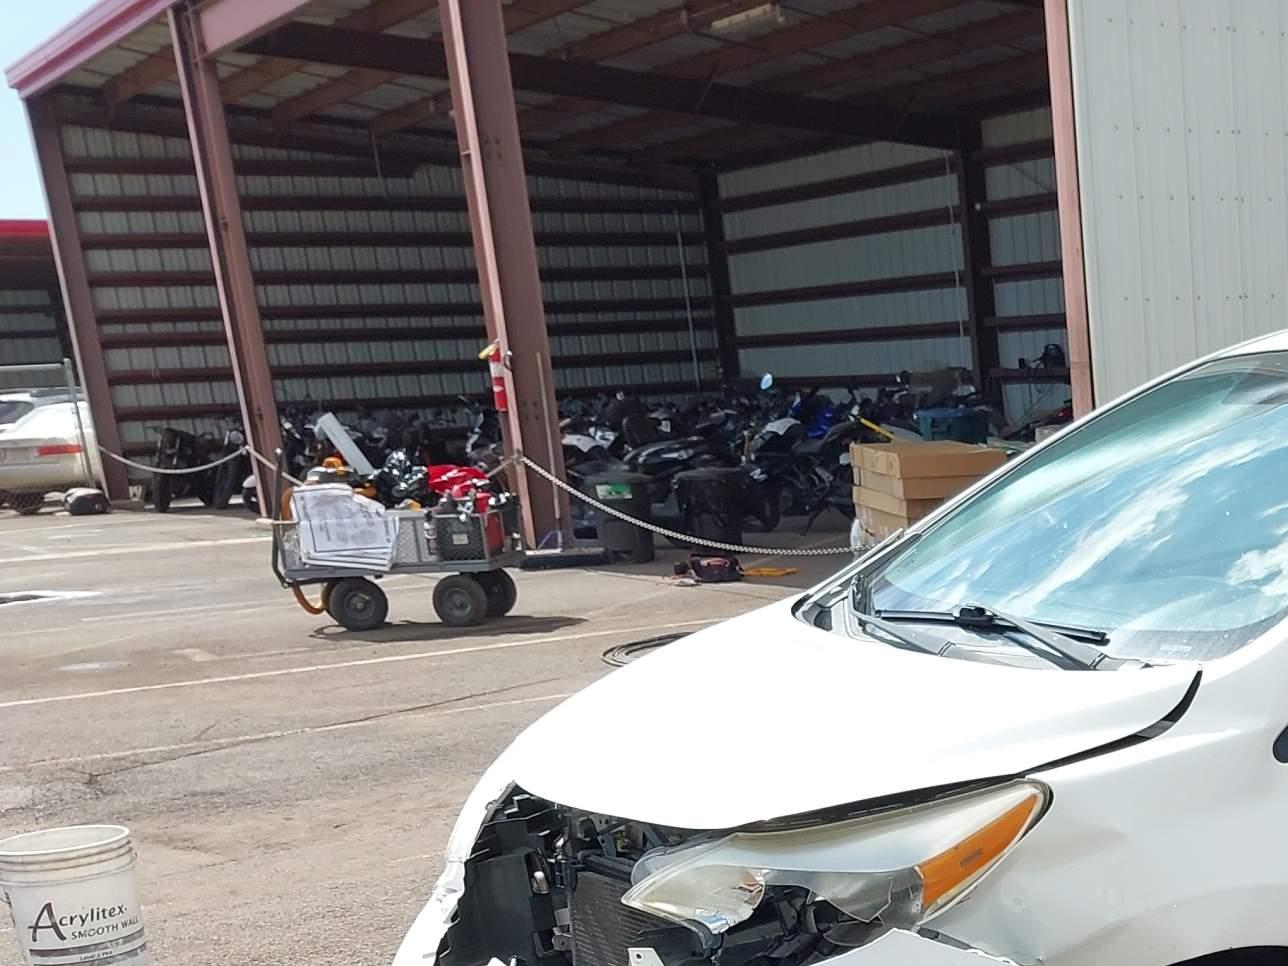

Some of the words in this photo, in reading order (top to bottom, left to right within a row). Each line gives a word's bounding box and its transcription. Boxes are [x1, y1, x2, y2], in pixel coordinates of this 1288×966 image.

[27, 902, 125, 943] Acrylitex
[71, 923, 119, 940] SMOOTH
[121, 915, 139, 929] WALL
